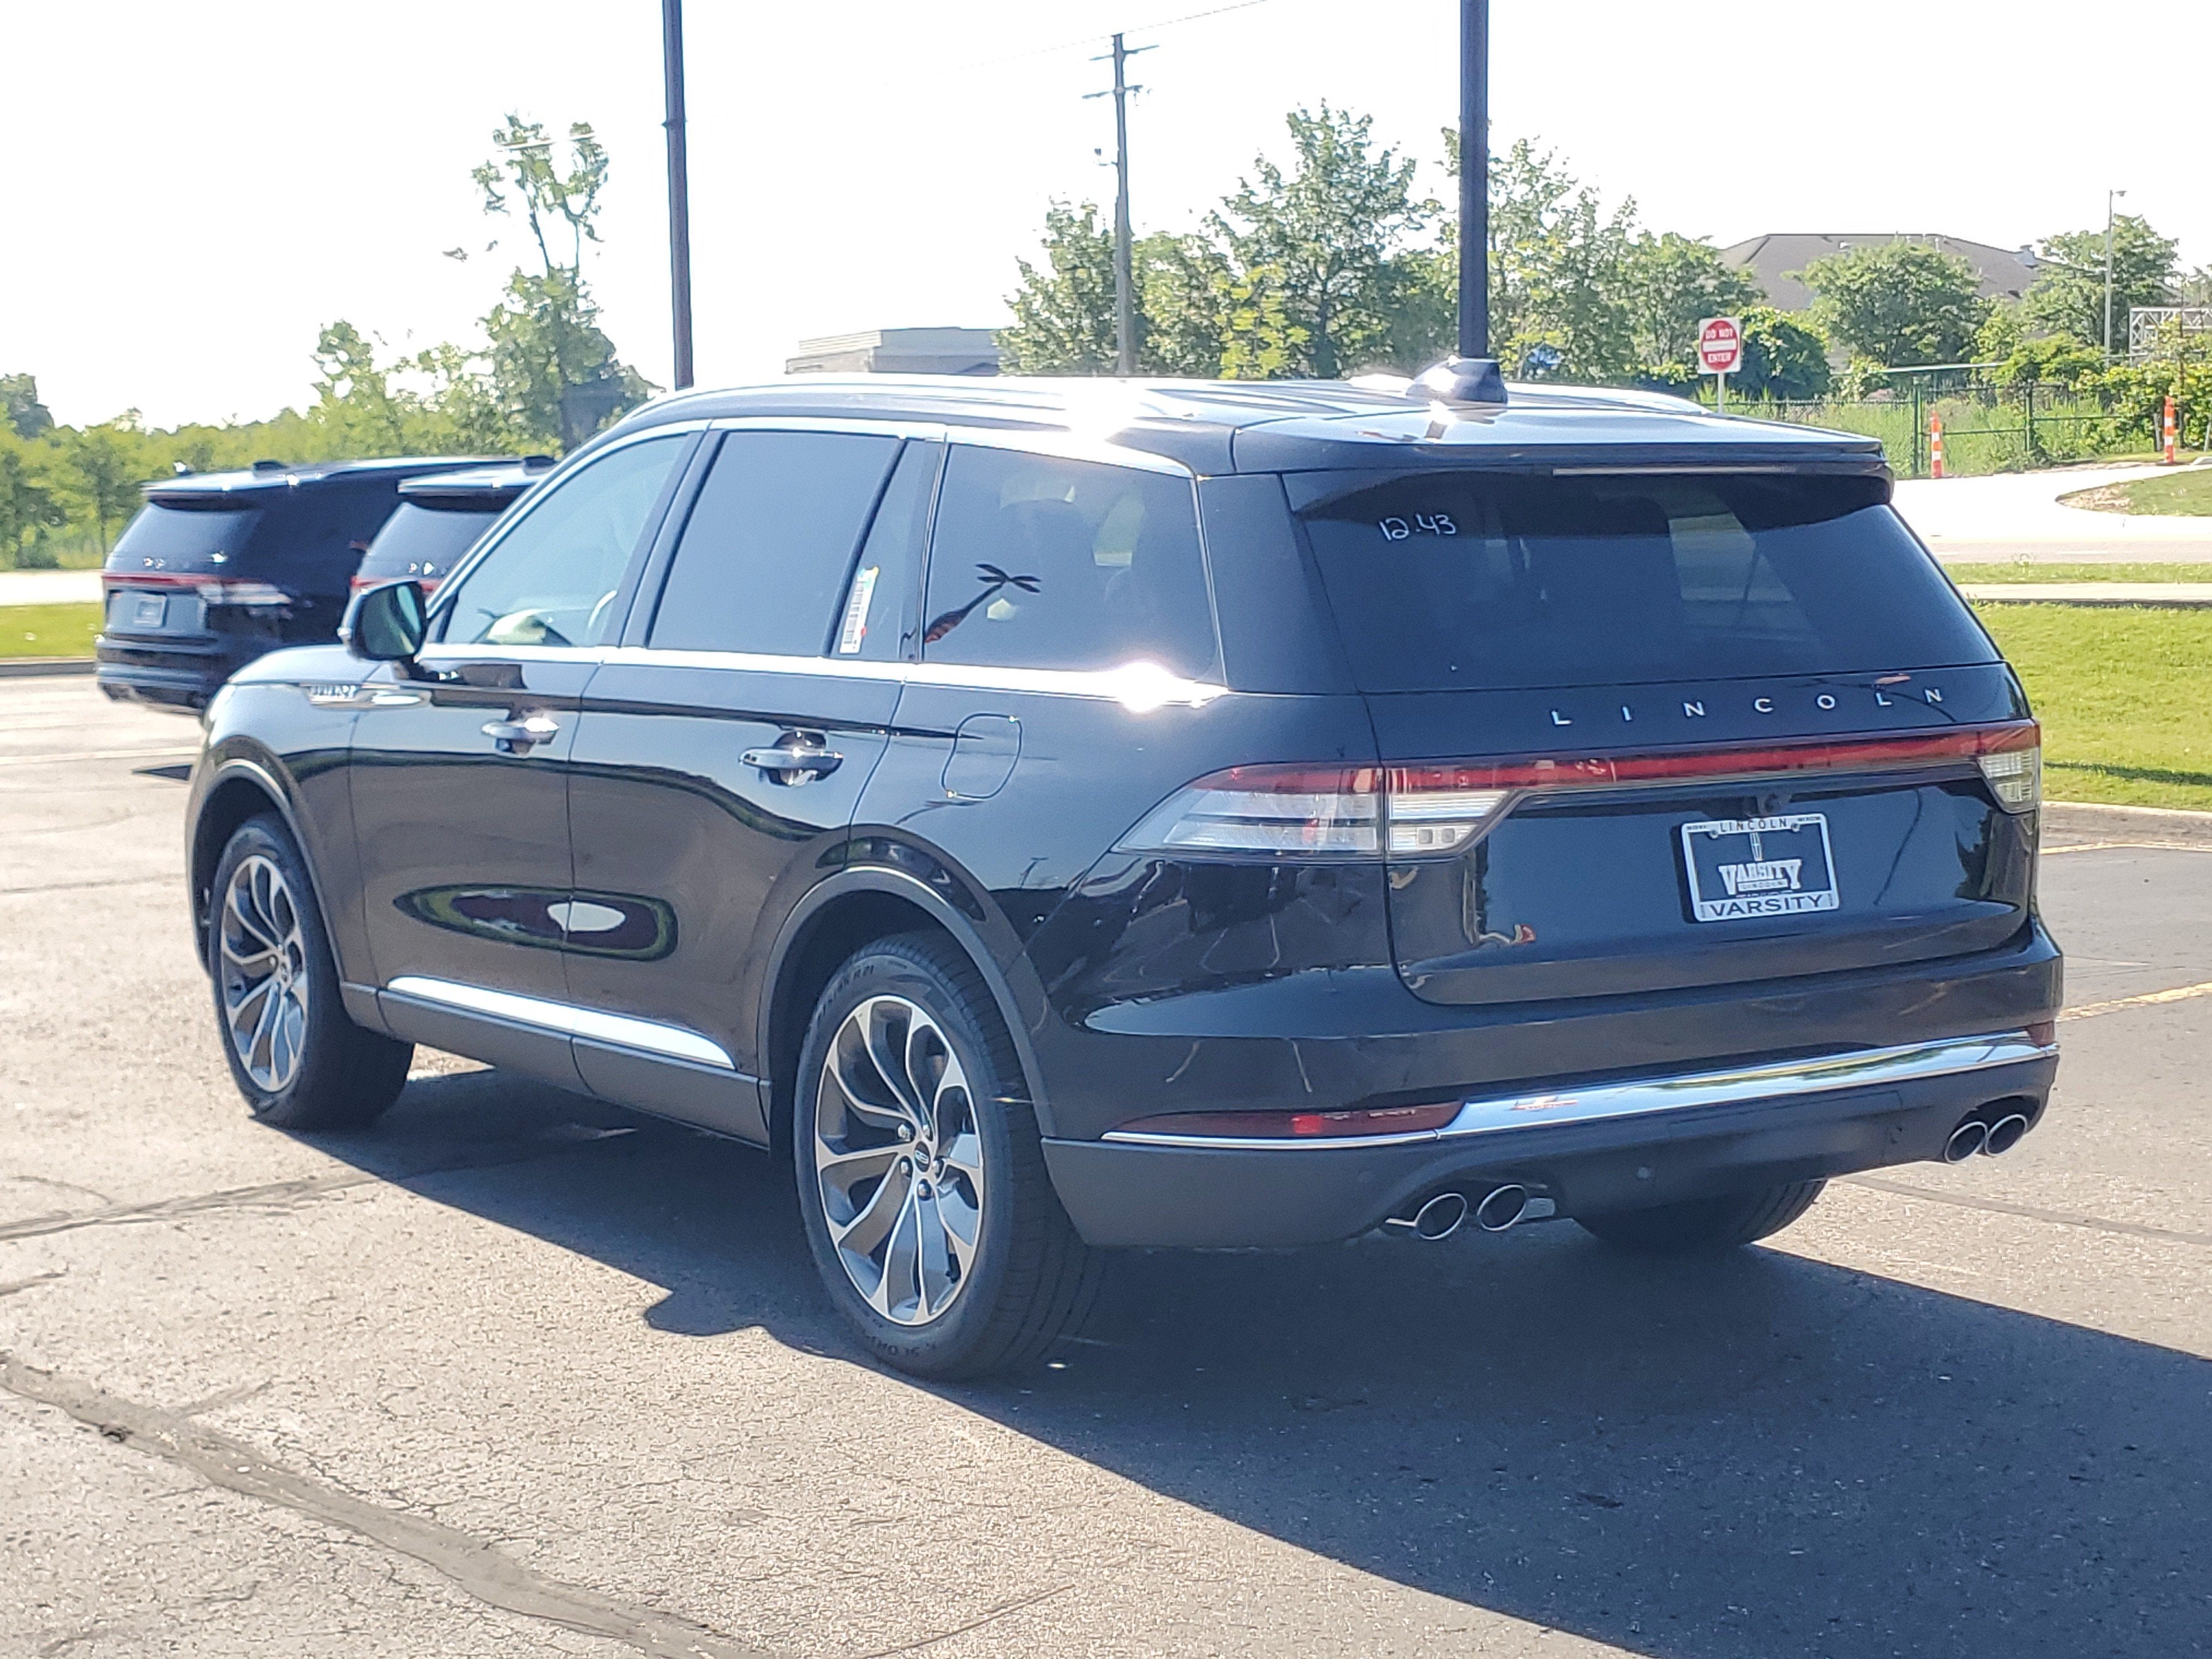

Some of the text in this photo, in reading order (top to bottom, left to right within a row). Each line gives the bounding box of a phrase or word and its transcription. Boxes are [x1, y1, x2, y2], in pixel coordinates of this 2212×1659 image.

[1551, 687, 1943, 726] LINCOLN
[1719, 817, 1787, 833] LINCOLN
[1718, 858, 1802, 896] VARSITY
[1710, 894, 1823, 917] VARSITY
